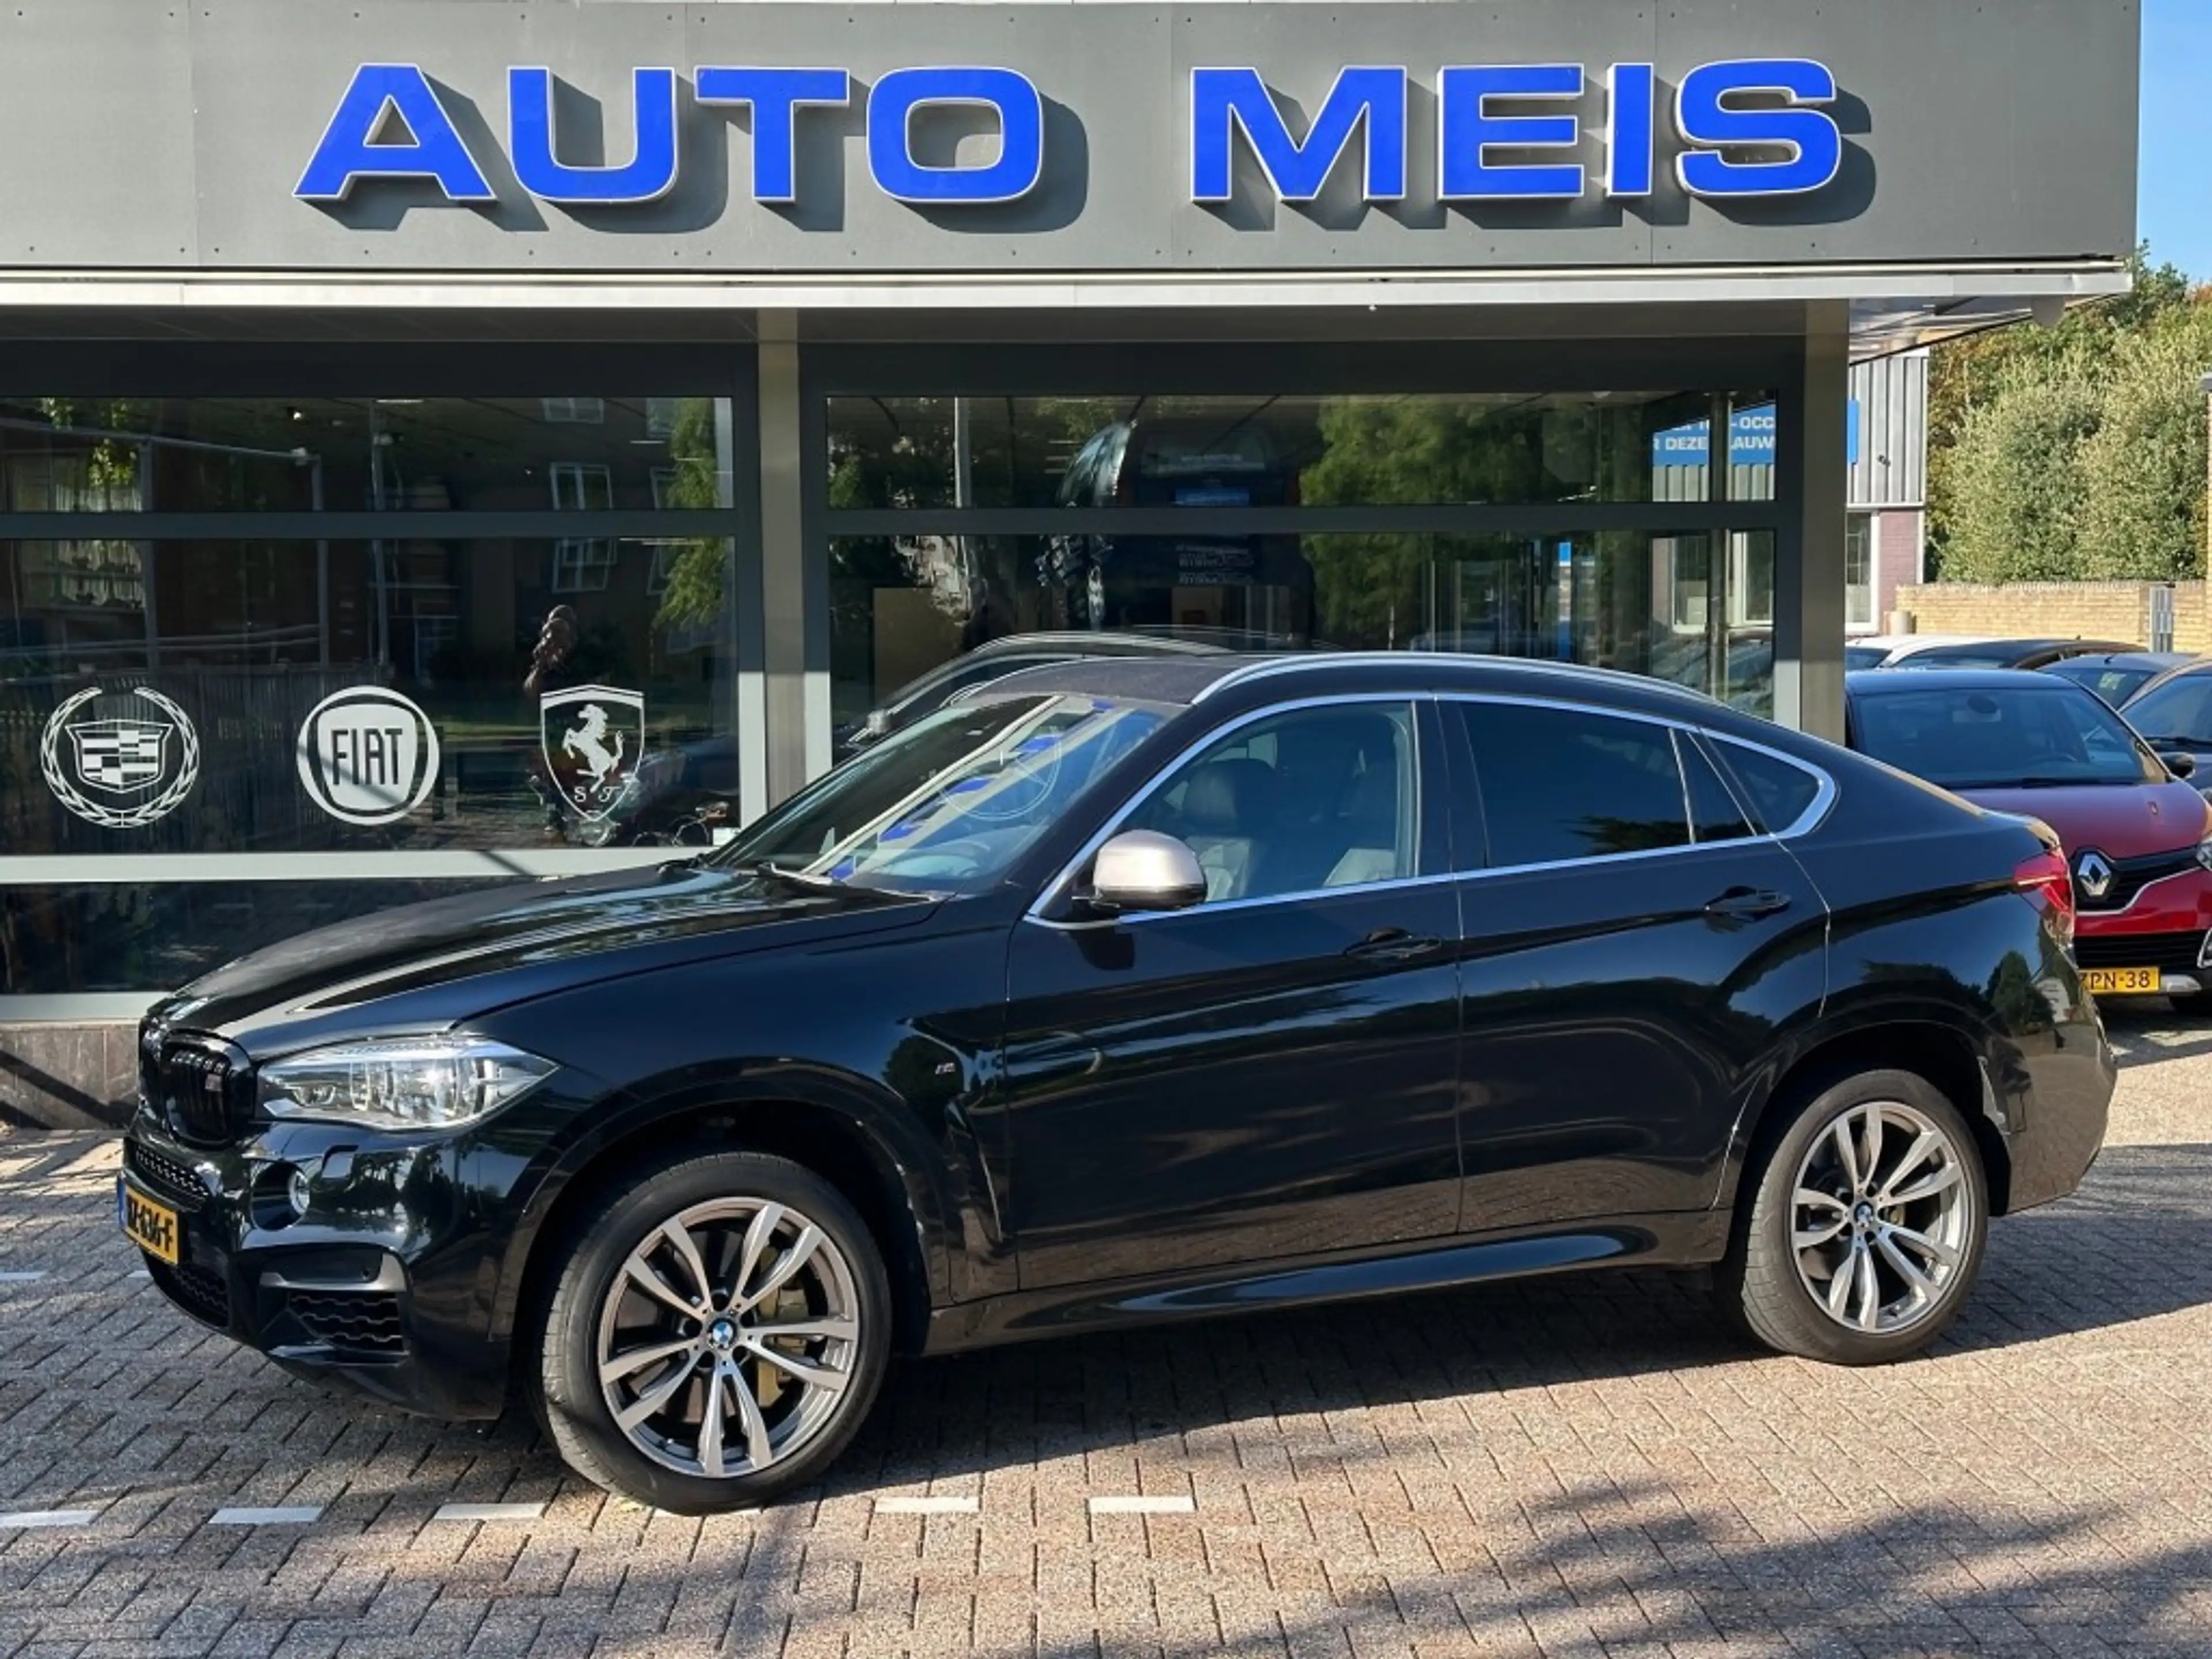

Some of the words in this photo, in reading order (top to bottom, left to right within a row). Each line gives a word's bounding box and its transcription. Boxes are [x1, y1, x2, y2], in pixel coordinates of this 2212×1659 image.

[292, 63, 1043, 203] AUTO
[1191, 59, 1842, 200] MEIS
[1665, 436, 1709, 450] DEZE
[331, 728, 403, 785] FIAT
[574, 786, 586, 802] S
